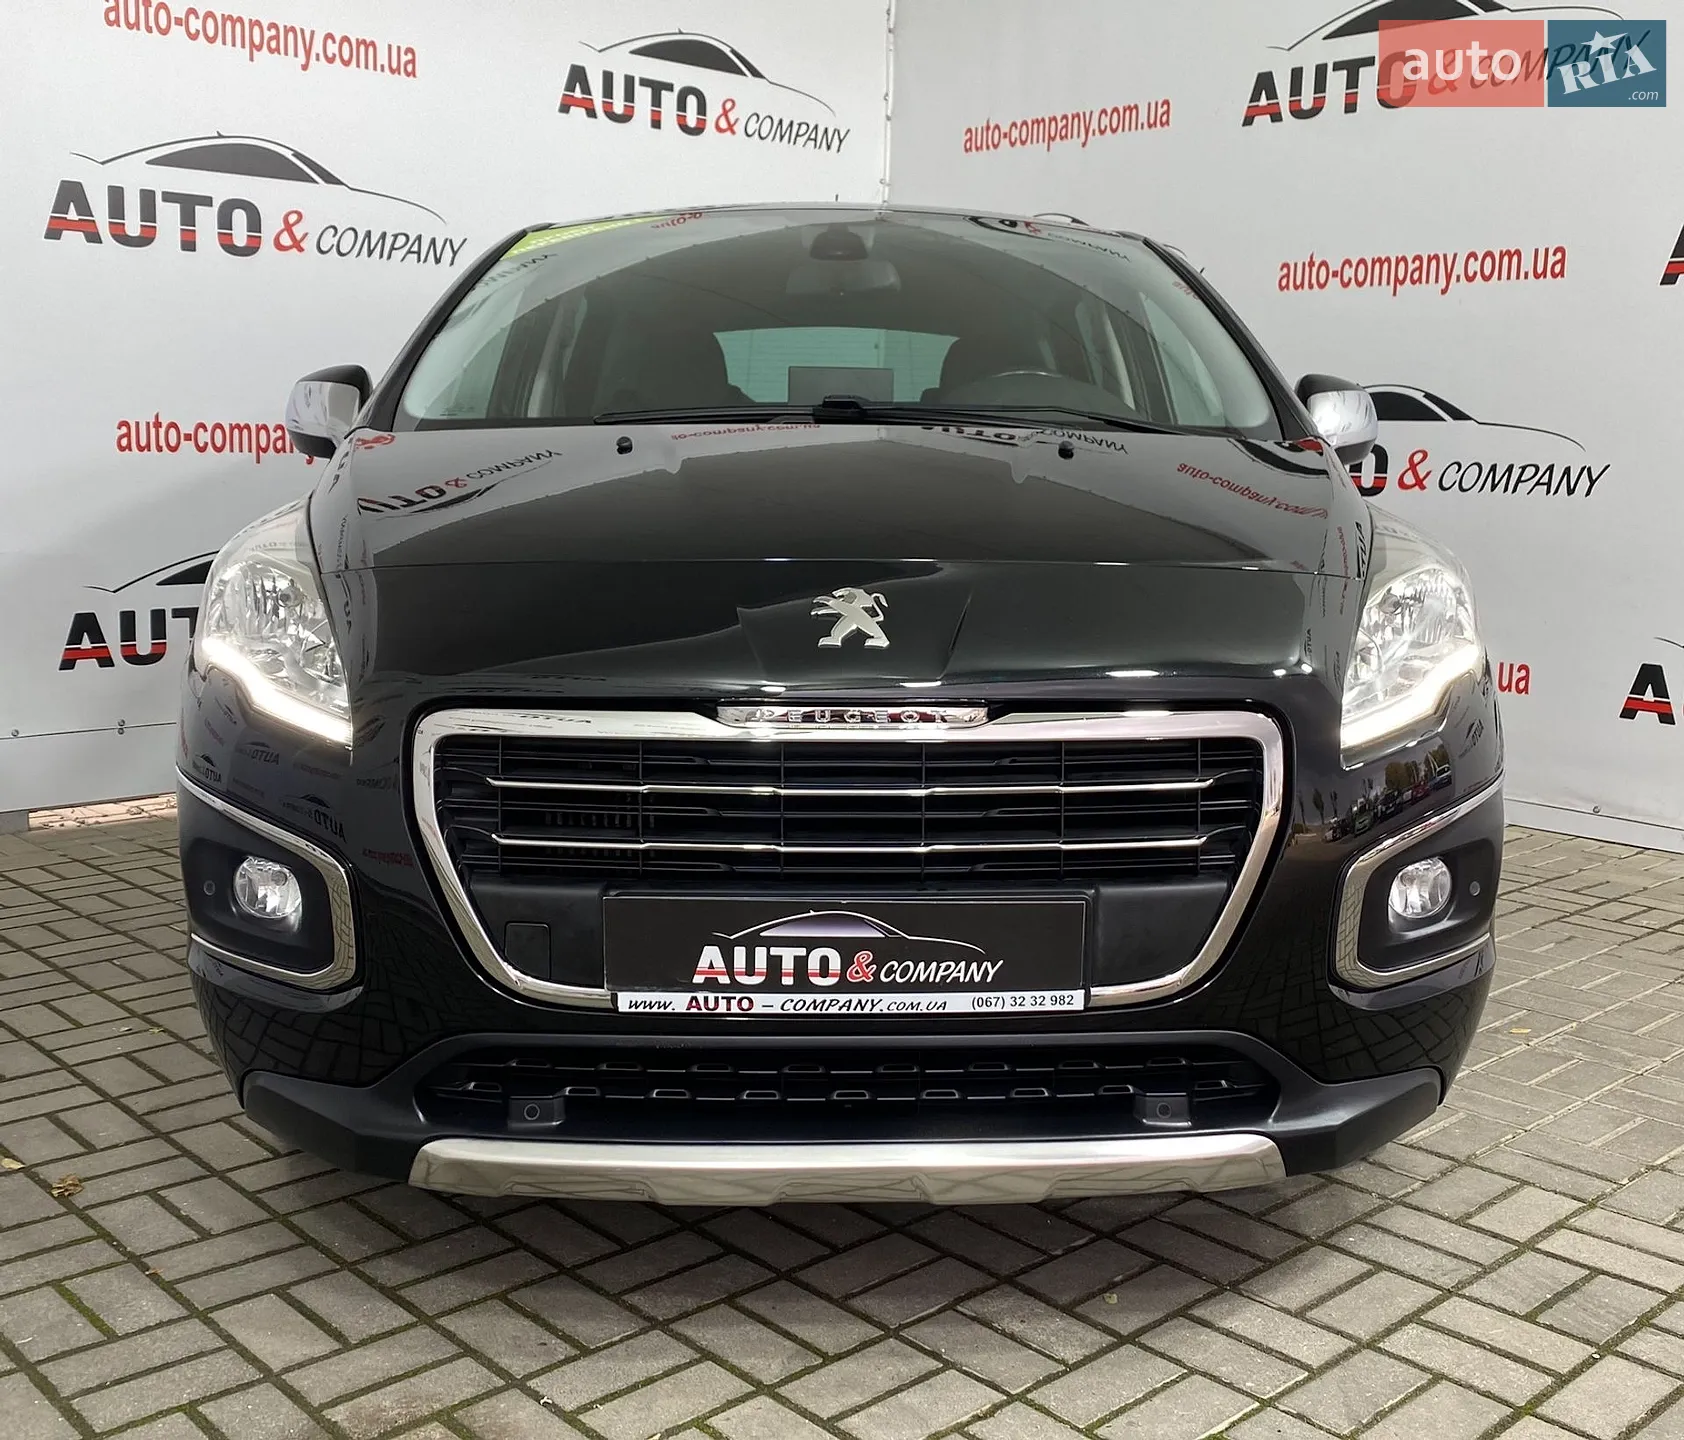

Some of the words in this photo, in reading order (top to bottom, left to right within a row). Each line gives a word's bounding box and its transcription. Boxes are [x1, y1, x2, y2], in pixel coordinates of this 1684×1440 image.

[103, 0, 416, 78] auto-company.com.ua
[557, 63, 708, 138] AUTO
[714, 98, 740, 136] &
[743, 113, 850, 154] COMPANY
[1242, 50, 1418, 127] AUTO
[963, 98, 1172, 154] auto-company.com.ua
[43, 179, 262, 258] AUTO
[272, 209, 309, 253] &
[315, 224, 468, 267] COMPANY
[1277, 245, 1568, 297] auto-company.com.ua
[115, 411, 314, 465] auto-compa
[1396, 448, 1432, 492] &
[1438, 460, 1611, 498] COMPANY
[755, 708, 948, 724] PEUGEOT
[1618, 662, 1684, 726] A
[691, 945, 841, 987] AUTO
[846, 950, 875, 982] &
[878, 959, 1004, 984] COMPANY
[627, 998, 675, 1012] www.
[685, 996, 754, 1012] AUTO
[971, 995, 1006, 1011] (067)
[1009, 996, 1025, 1008] 32
[1030, 995, 1046, 1007] 32
[1050, 994, 1075, 1007] 982
